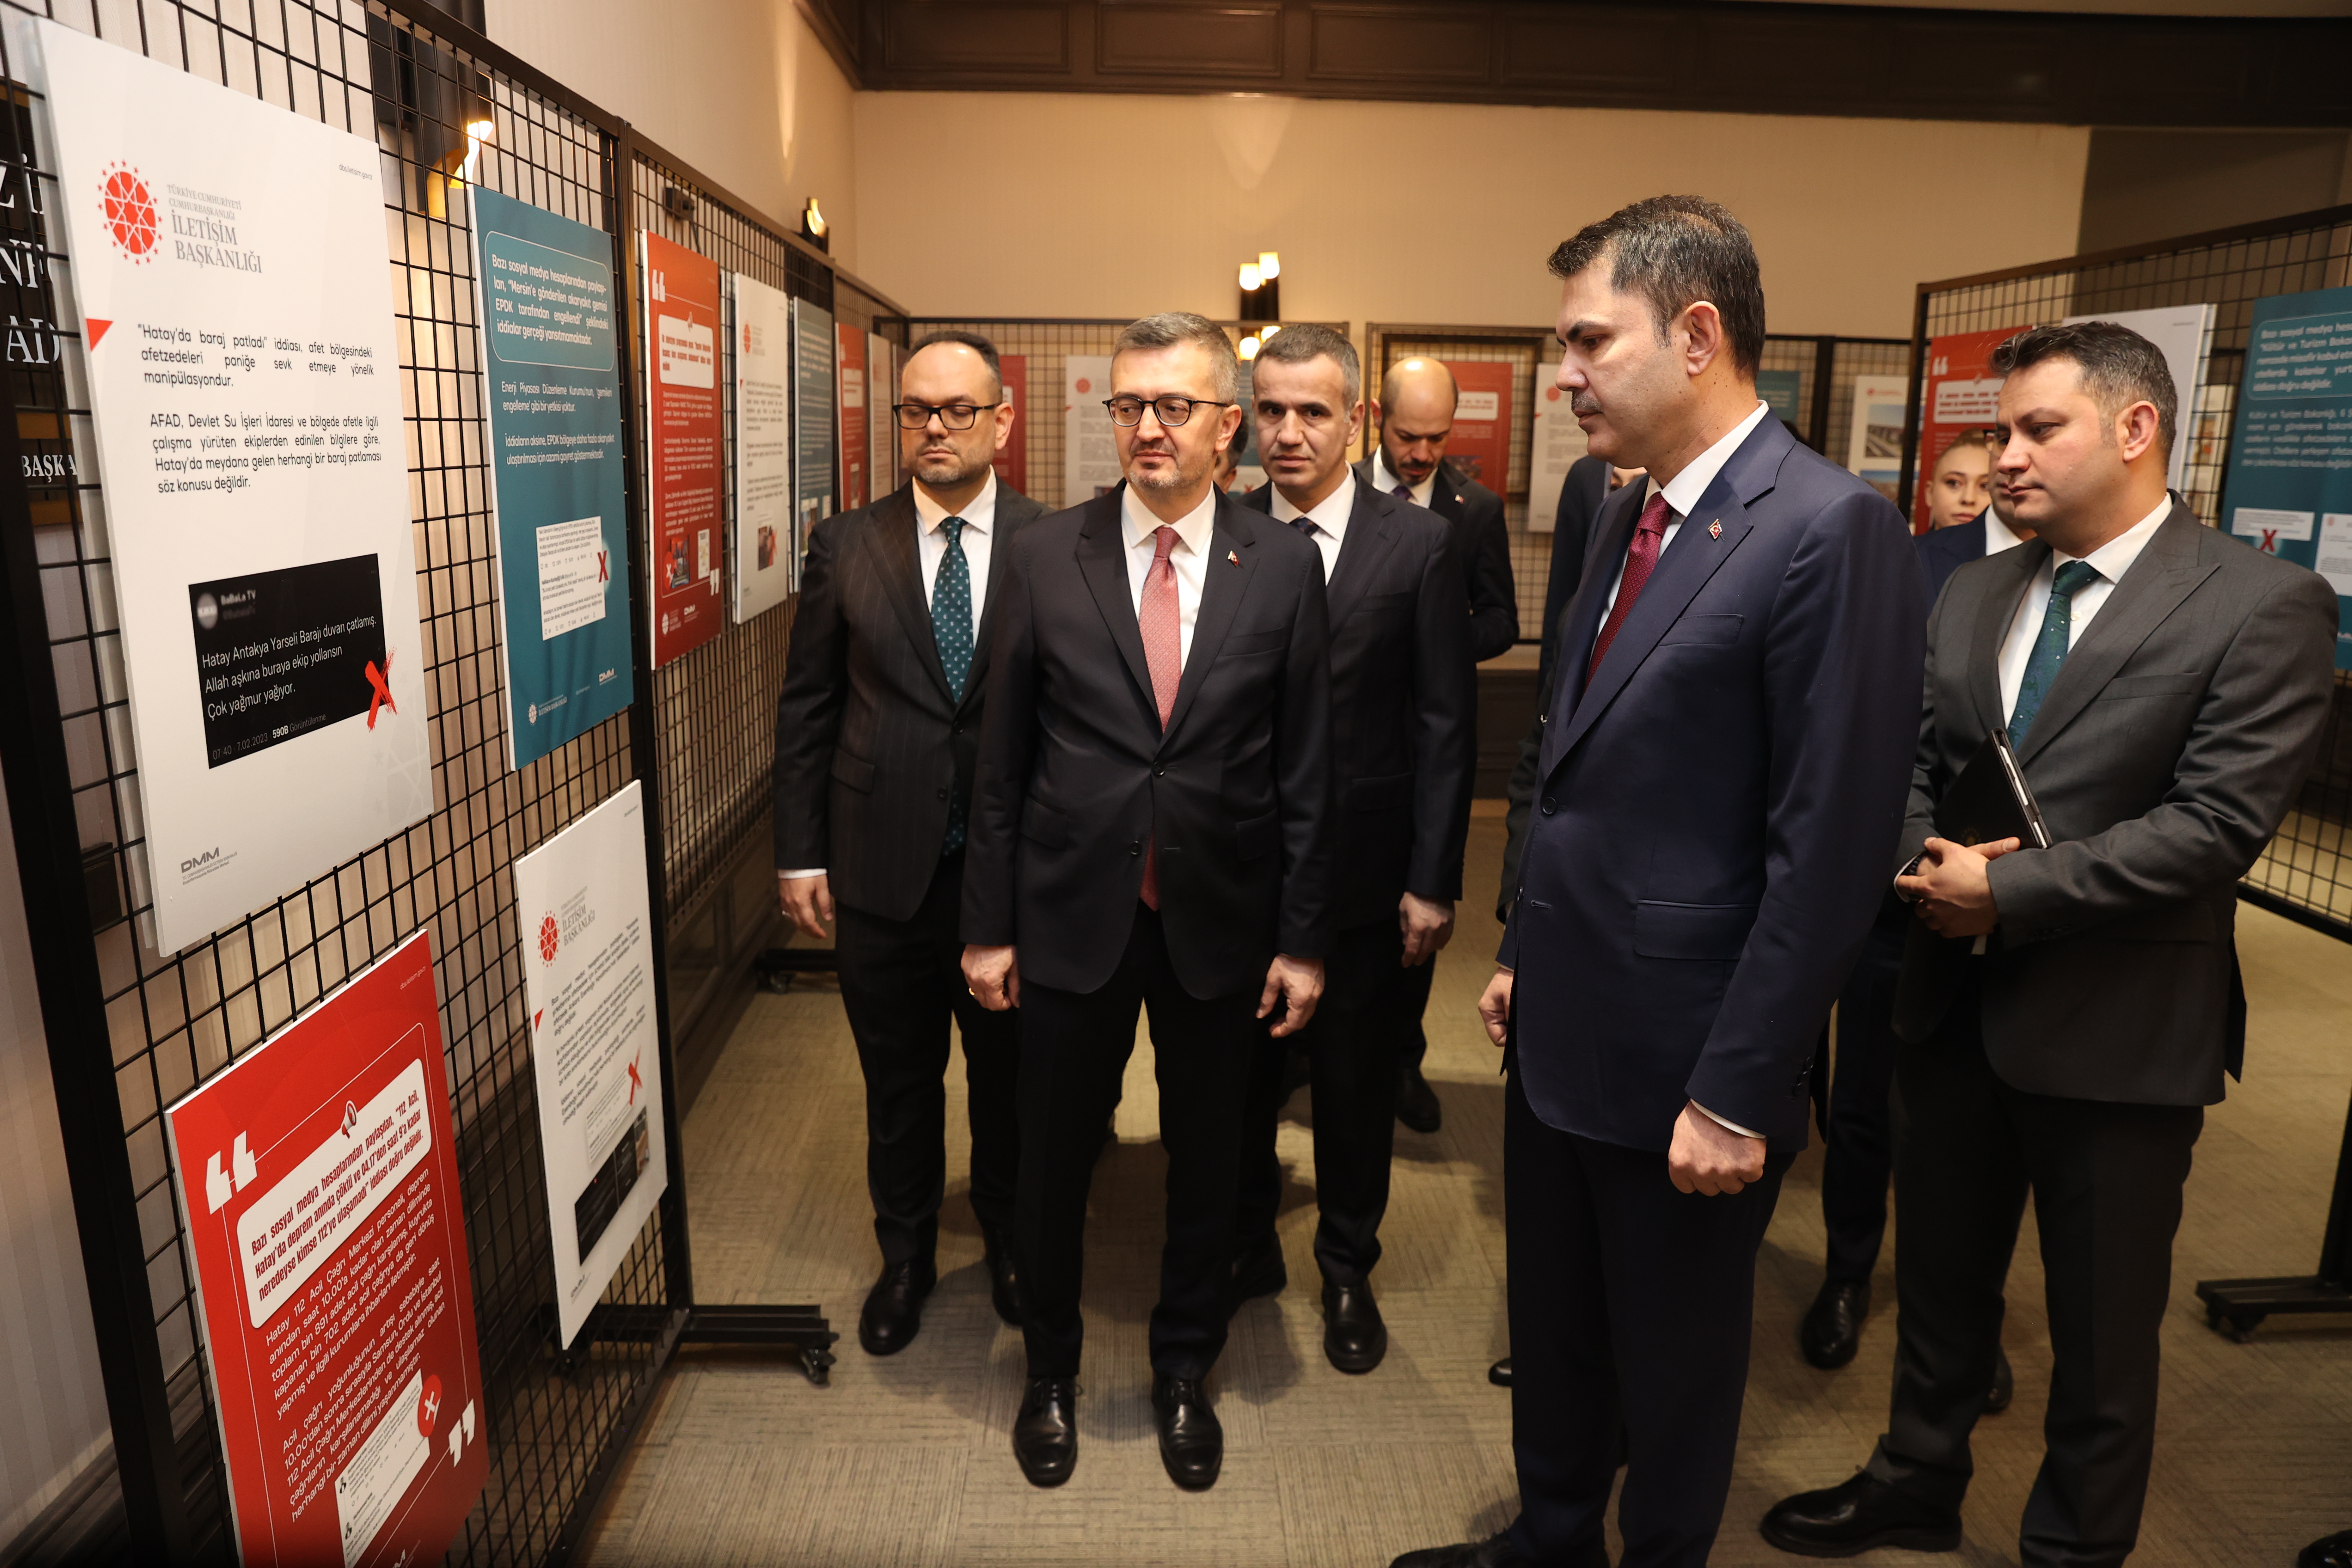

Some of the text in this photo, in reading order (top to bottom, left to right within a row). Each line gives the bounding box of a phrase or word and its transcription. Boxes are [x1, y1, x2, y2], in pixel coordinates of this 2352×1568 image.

[0, 153, 44, 215] Zİ
[338, 163, 372, 180] dbs.iletisim.gov.tr
[166, 184, 242, 210] TÜRKİYE CUMHURİYETİ
[168, 197, 235, 220] CUMHURBAŞKANLIĞI
[171, 208, 238, 247] İLETİŞİM
[0, 238, 53, 288] NF
[175, 239, 262, 273] BAŞKANLIĞI
[491, 253, 507, 270] Bazı
[508, 260, 528, 276] sosyal
[529, 265, 549, 282] medya
[495, 297, 514, 313] EPDK
[518, 302, 550, 319] tarafından
[537, 285, 567, 303] gönderilen
[199, 330, 226, 349] baraj
[274, 337, 303, 352] iddiası,
[309, 341, 325, 354] afet
[330, 343, 372, 359] bölgesindeki
[496, 318, 522, 335] iddialar
[522, 325, 545, 341] gerçeği
[141, 346, 374, 377] afetzedeleri paniğe sevk etmeye yönelik
[144, 370, 233, 389] manipülasyondur.
[150, 411, 378, 431] AFAD, Devlet Su İşleri İdaresi ve bölgede afetle ilgili
[152, 433, 380, 453] çalışma yürüten ekiplerden edinilen bilgilere göre,
[155, 450, 381, 474] Hatay'da meydana gelen herhangi bir baraj patlaması
[158, 475, 250, 493] söz konusu değildir.
[202, 616, 377, 668] Hatay Antakya Yarseli Barajı duvarı çatlamış.
[205, 646, 342, 693] Allah aşkına buraya ekip yollansın
[207, 683, 296, 721] Çok yağmur yağıyor.
[212, 744, 232, 760] 07:40
[236, 732, 268, 751] 7.02.2023
[272, 725, 289, 738] 590B
[180, 846, 220, 873] DMM
[251, 1232, 267, 1256] Bazı
[270, 1206, 294, 1238] sosyal
[296, 1185, 319, 1214] medya
[321, 1143, 363, 1191] hesaplarından
[365, 1115, 394, 1151] paylaşılan,
[407, 1089, 419, 1108] Acil,
[254, 1109, 421, 1279] Hatay'da deprem anında çöktü ve 04.17'den saat 9'a kadar
[258, 1256, 296, 1302] neredeyse
[296, 1235, 317, 1264] kimse
[317, 1216, 337, 1243] 112'ye
[369, 1164, 388, 1191] iddiası
[388, 1148, 404, 1171] doğru
[403, 1129, 423, 1155] değildir.
[266, 1168, 429, 1347] Hatay 112 Acil Çağrı Merkezi personeli, deprem
[269, 1183, 431, 1365] anından saat 10.00'a kadar olan zaman diliminde
[271, 1198, 432, 1382] toplam bin 891 adet acil çağrı karşılamış, kuyrukta
[274, 1213, 435, 1401] kapanan bin 702 adet acil çağrıya da geri dönüş
[276, 1253, 416, 1421] yapmış ve ilgili kurumlara ihbarları iletmiştir.
